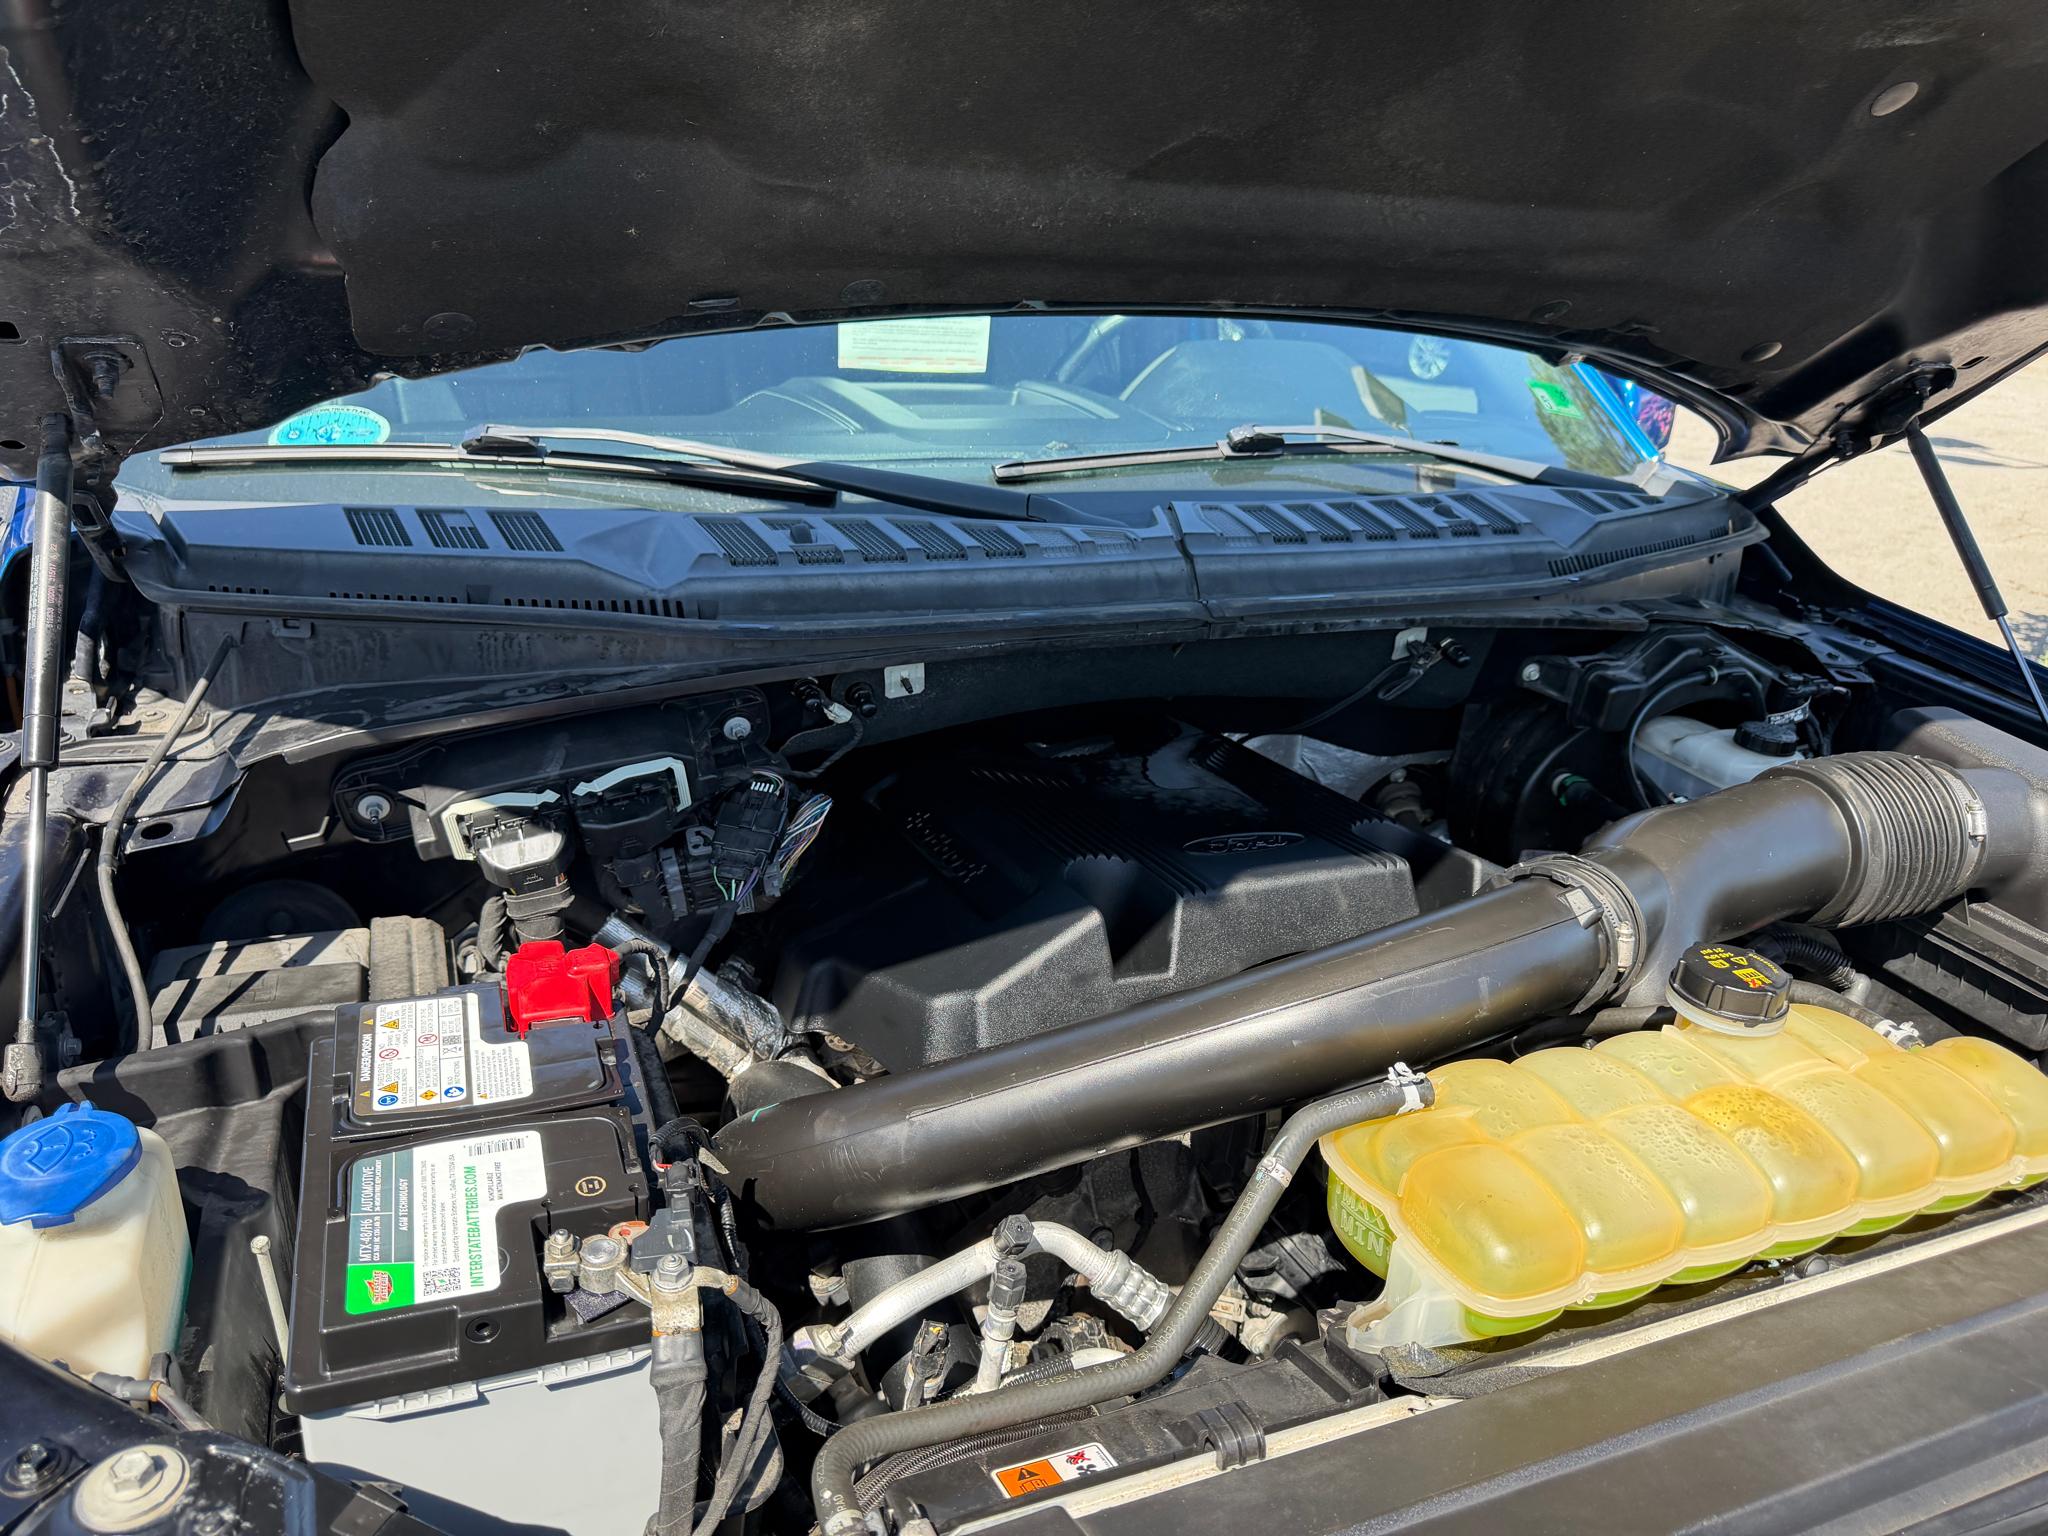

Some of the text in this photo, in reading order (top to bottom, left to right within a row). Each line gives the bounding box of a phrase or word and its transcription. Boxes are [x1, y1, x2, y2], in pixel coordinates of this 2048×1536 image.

[361, 1166, 375, 1211] AUTOMOTIVE
[398, 1178, 409, 1231] AGM TECHNOLOGY
[1341, 1183, 1385, 1231] MAX
[463, 1166, 484, 1287] INTERSTATEBATTERIES.COM
[1340, 1209, 1385, 1257] MIN
[373, 1271, 381, 1304] INTERSTATE
[380, 1272, 388, 1302] BATTERIES
[833, 1494, 847, 1512] RAD
